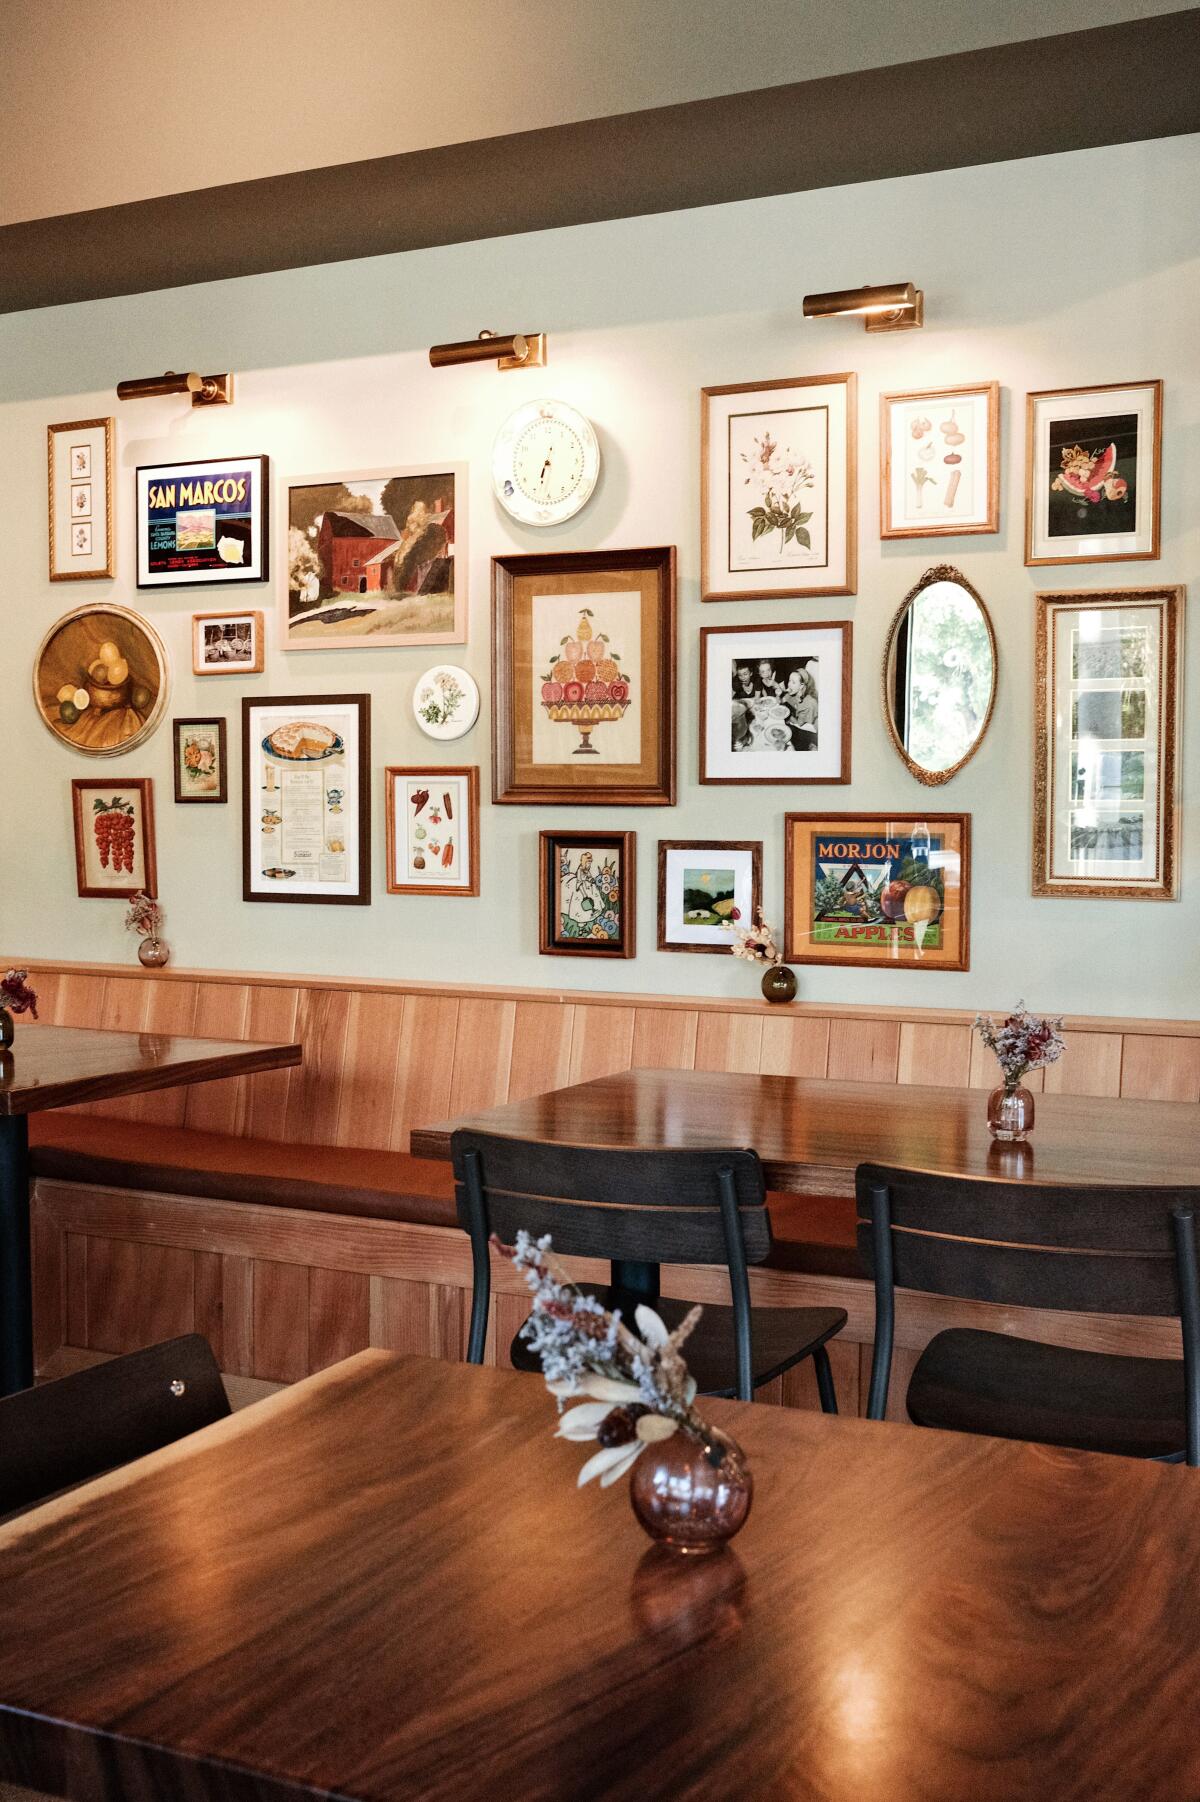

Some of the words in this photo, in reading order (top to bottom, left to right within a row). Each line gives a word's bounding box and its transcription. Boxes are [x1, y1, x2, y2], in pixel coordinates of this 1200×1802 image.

[149, 485, 176, 509] SAN
[179, 478, 246, 507] MARCOS
[150, 540, 176, 550] LEMONS
[819, 843, 901, 859] MORJON
